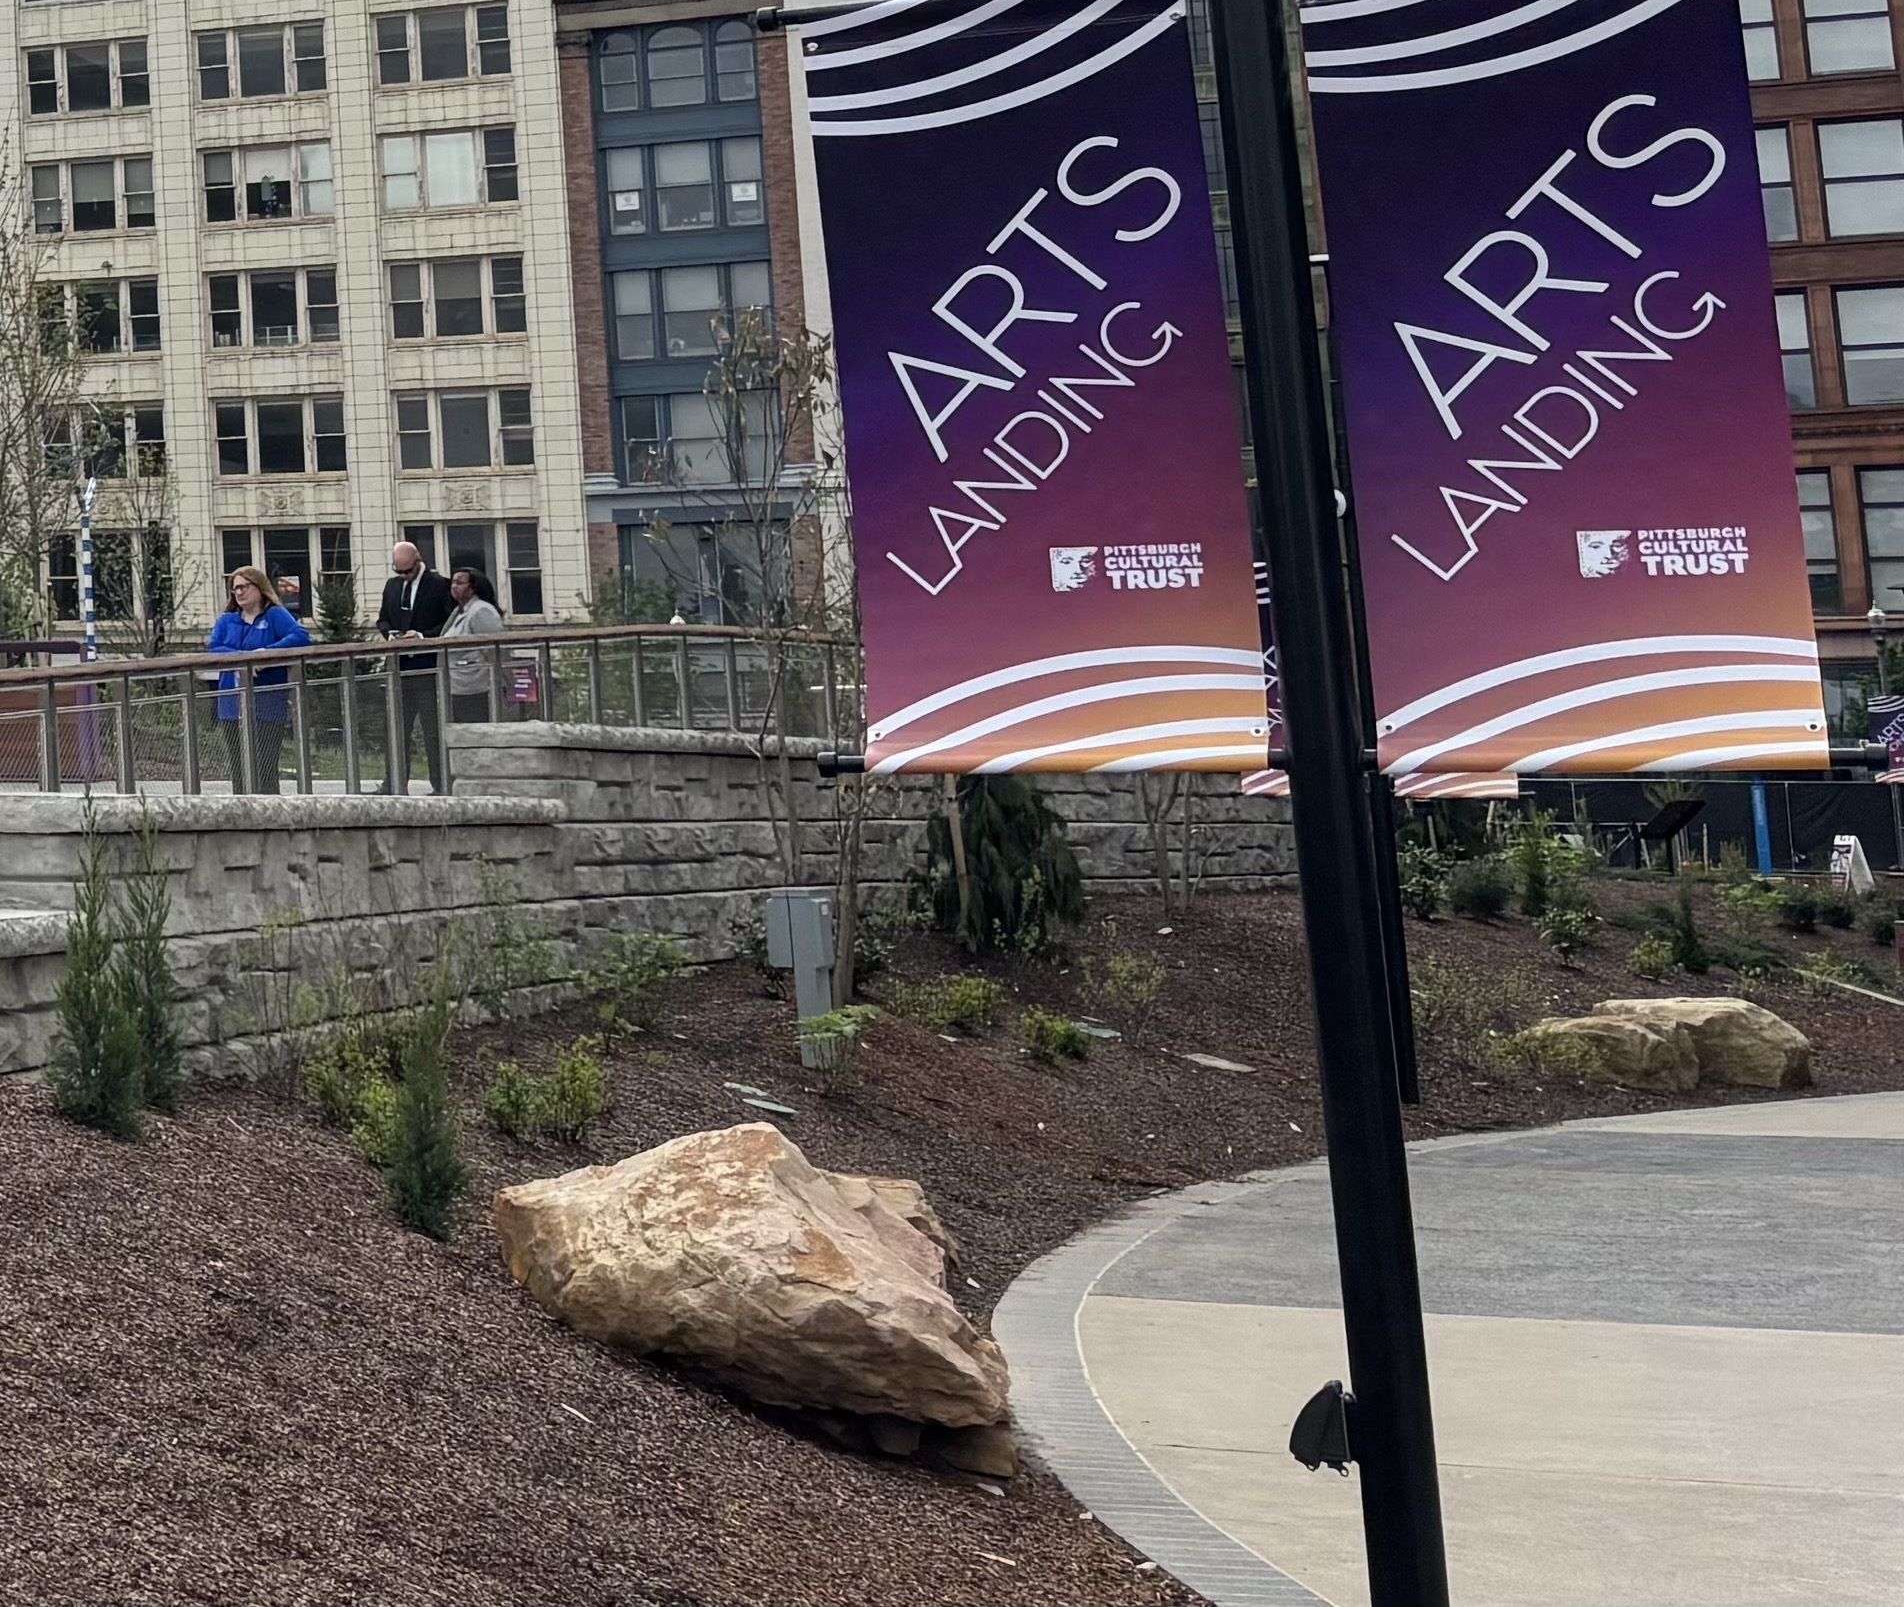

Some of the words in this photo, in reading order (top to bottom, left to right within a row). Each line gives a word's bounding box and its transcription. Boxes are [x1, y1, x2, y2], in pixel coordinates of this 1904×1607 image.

[1393, 94, 1727, 441] ARTS
[888, 135, 1181, 463] ARTS
[1392, 270, 1727, 582] LANDING
[887, 301, 1183, 596] LANDING
[1637, 526, 1747, 541] PITTSBURGH
[1103, 542, 1202, 556] PITTSBURGH
[1638, 538, 1749, 555] CULTURAL
[1104, 554, 1203, 570] CULTURAL
[1640, 552, 1749, 576] TRUST
[1106, 567, 1204, 590] TRUST
